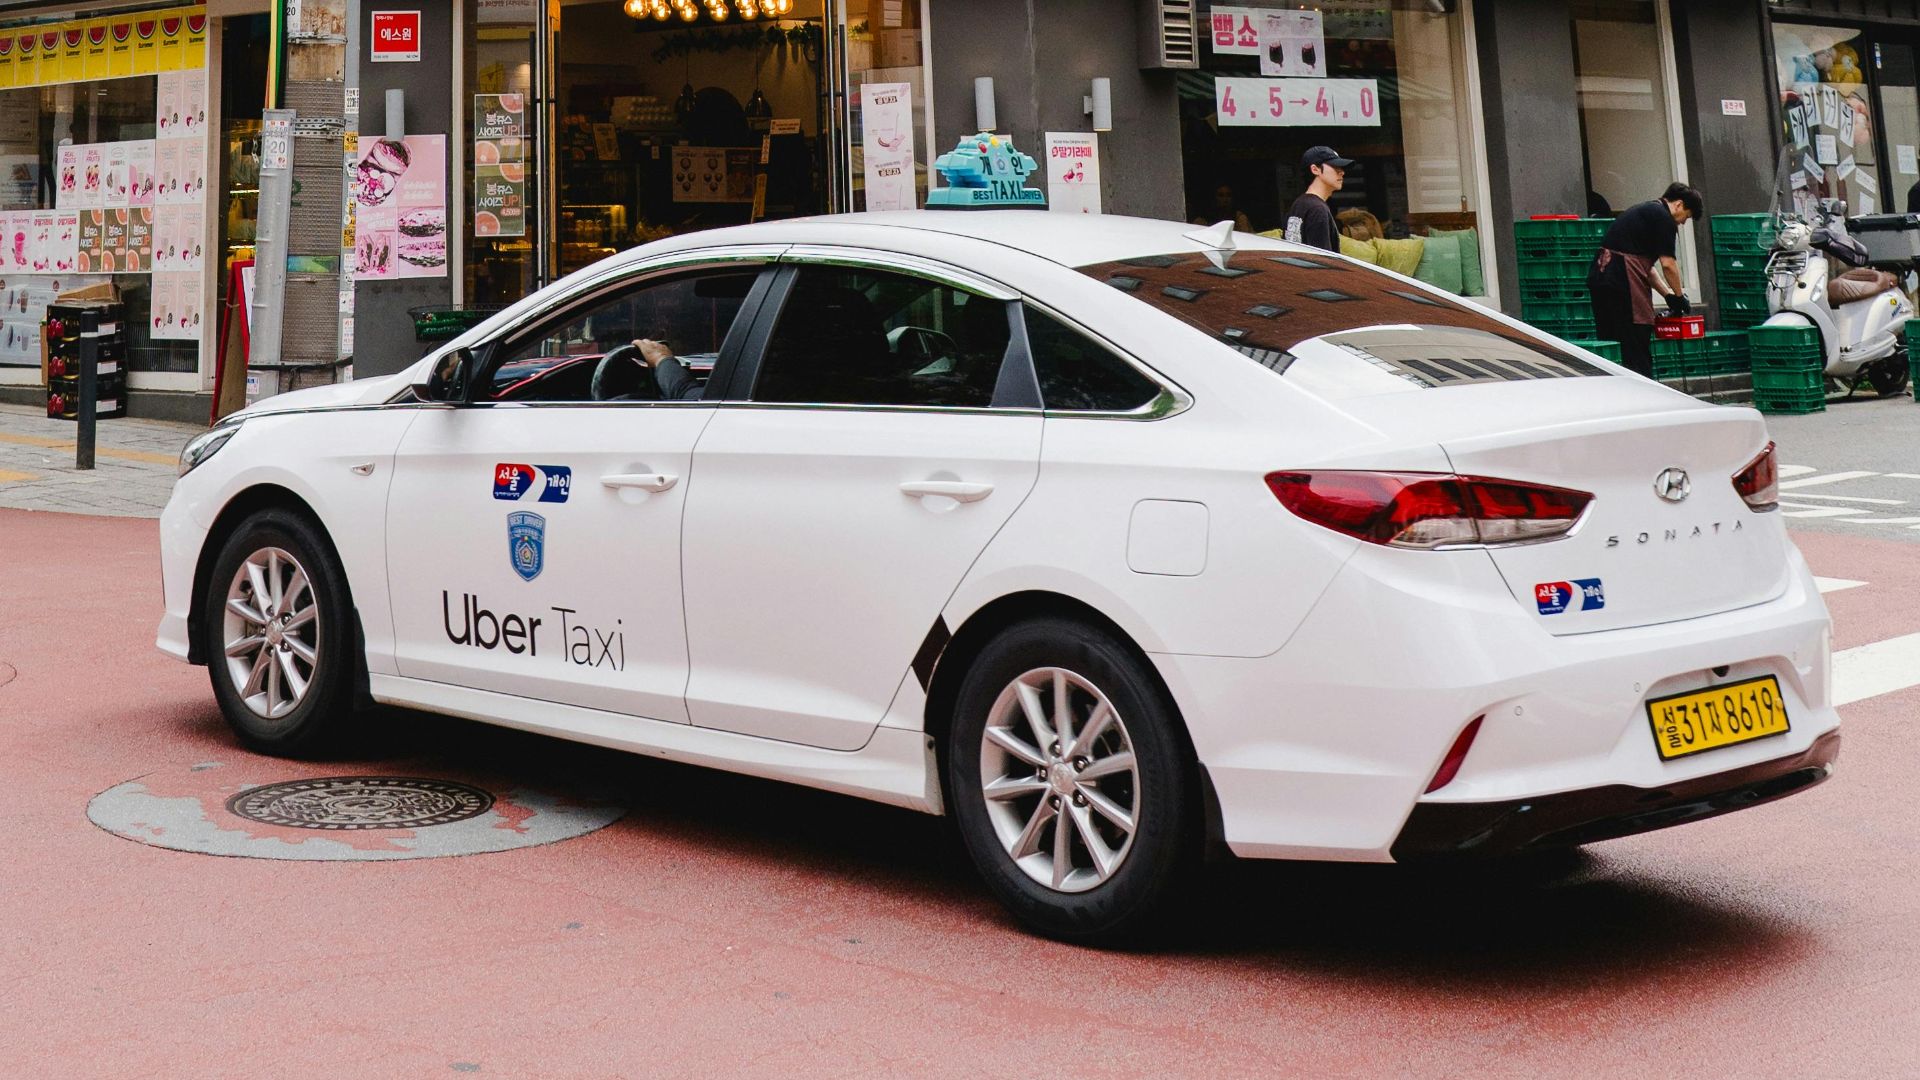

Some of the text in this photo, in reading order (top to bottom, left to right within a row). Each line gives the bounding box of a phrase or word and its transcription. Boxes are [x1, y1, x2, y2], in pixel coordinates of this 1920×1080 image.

[380, 27, 412, 41] 에스원
[1213, 13, 1259, 48] 뱅쇼
[486, 112, 513, 126] 봉쥬스
[270, 140, 286, 154] 20
[486, 183, 514, 195] 봉쥬스
[973, 180, 1042, 200] BEST TAXI DRIVER
[498, 465, 571, 495] 서울 개인
[510, 515, 523, 525] BEST
[1605, 518, 1744, 549] SONATA
[1538, 584, 1605, 606] 서울 개인
[442, 589, 625, 672] Uber Taxi
[1662, 705, 1682, 749] 서울
